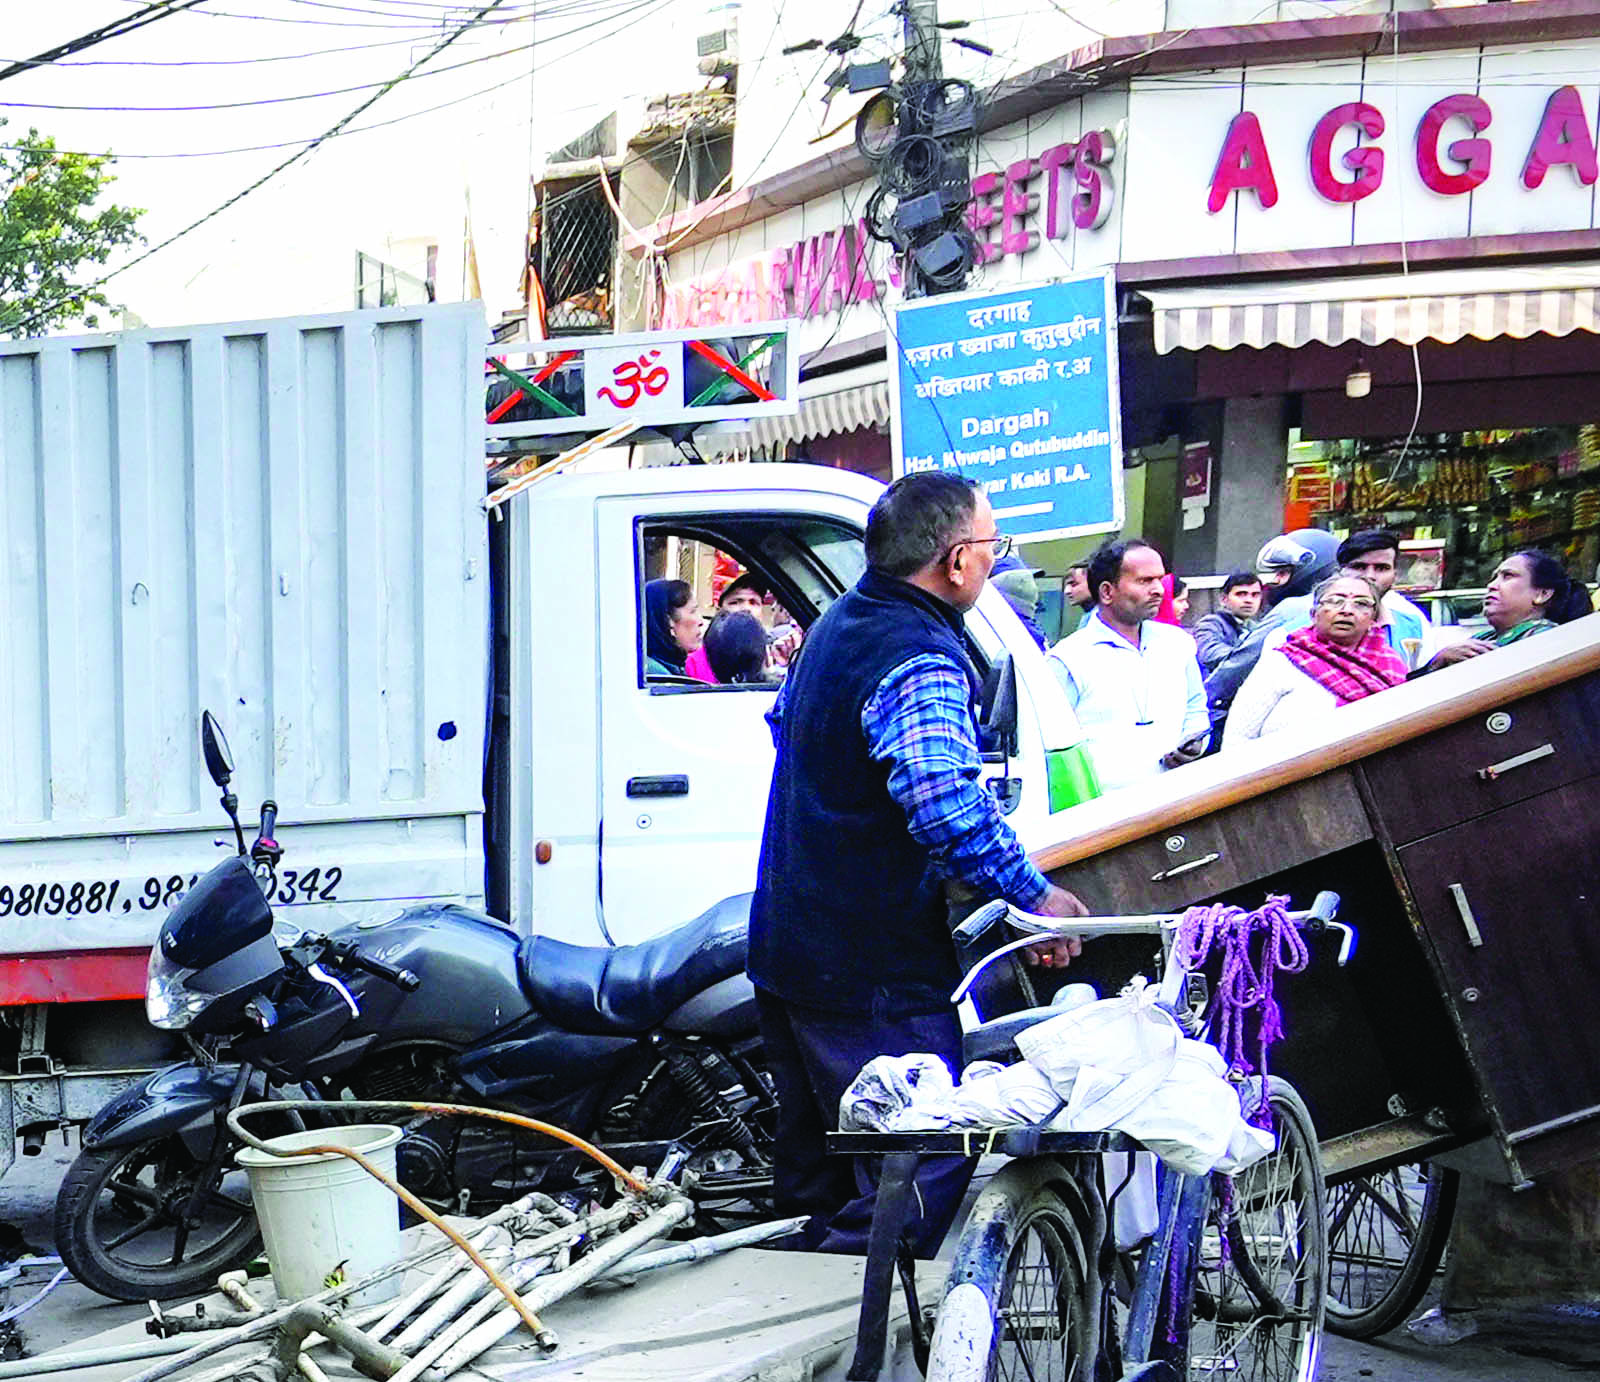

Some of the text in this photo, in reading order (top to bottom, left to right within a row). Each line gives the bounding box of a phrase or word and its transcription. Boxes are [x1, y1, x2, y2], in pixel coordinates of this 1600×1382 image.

[966, 131, 1115, 265] EETS
[967, 300, 1033, 329] दरगाह
[996, 358, 1050, 388] काकी
[961, 407, 1050, 439] Dargah
[905, 429, 1110, 474] Hzt. Khwaja Qutubuddin
[1011, 469, 1050, 491] Kaki
